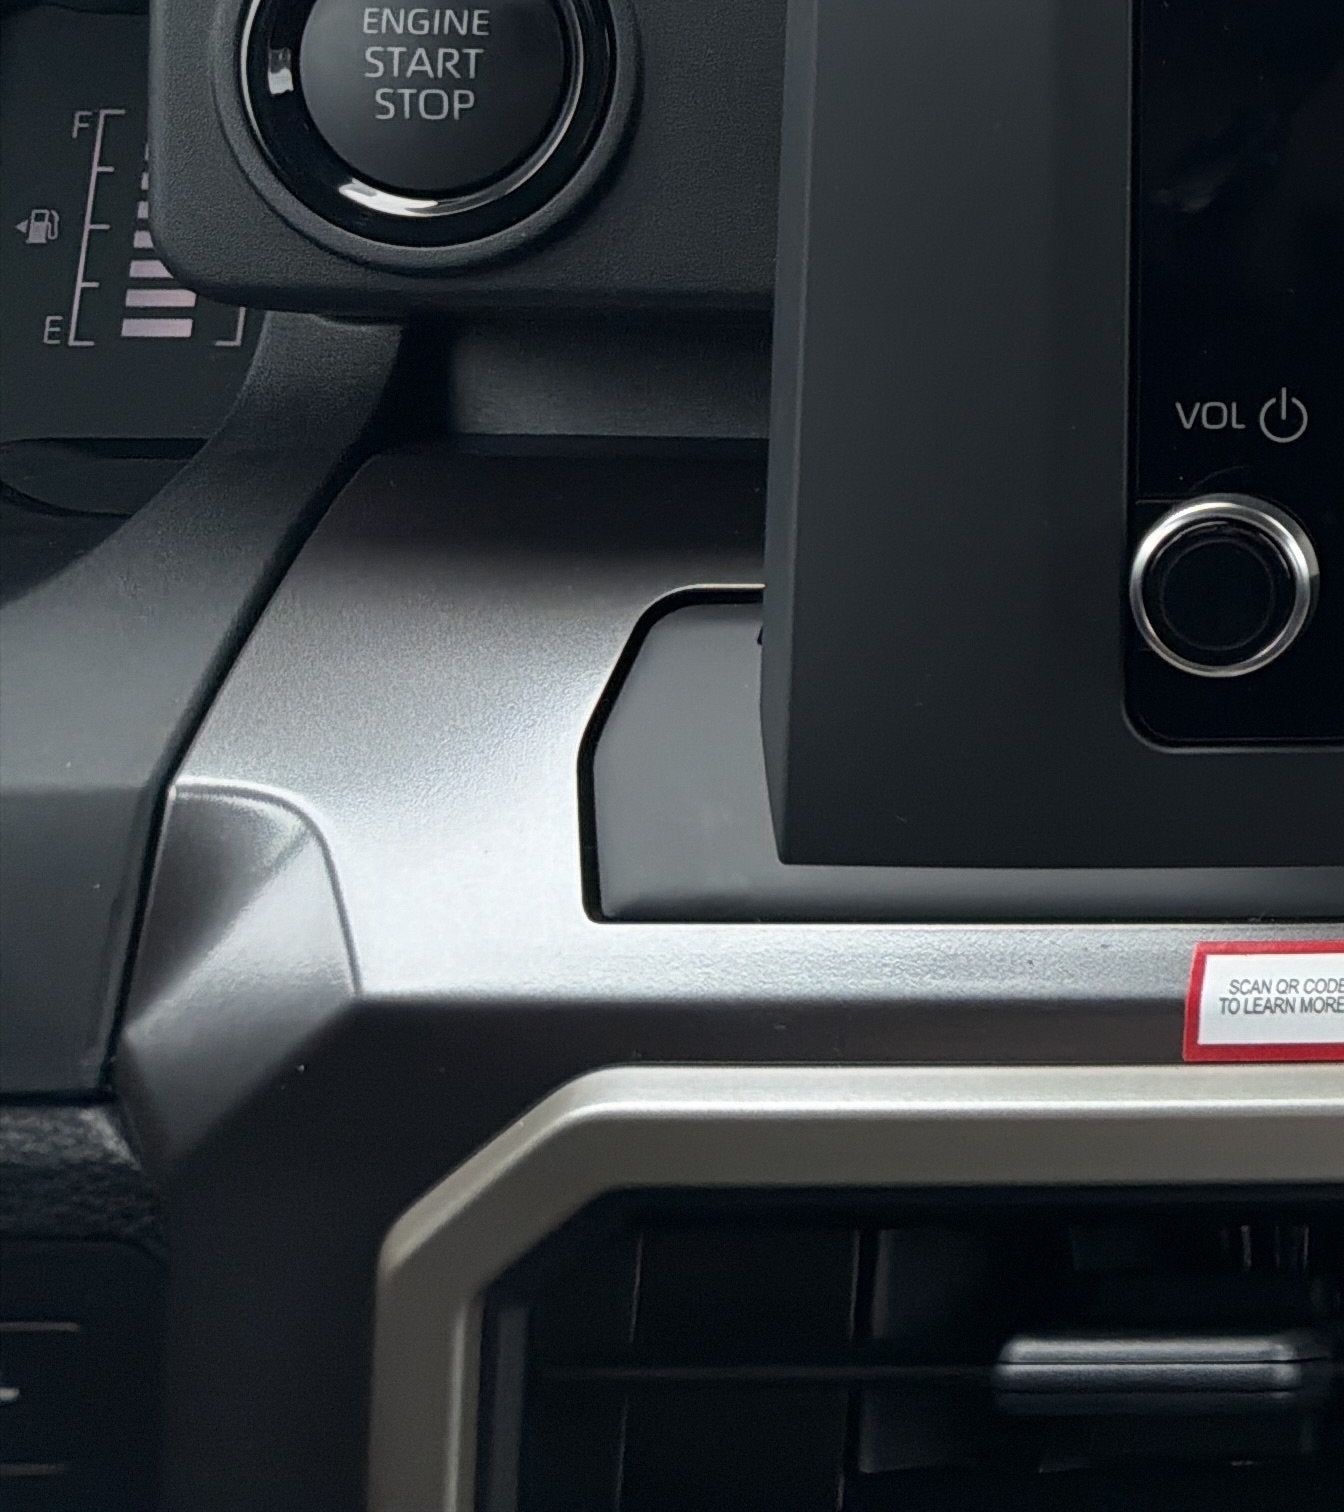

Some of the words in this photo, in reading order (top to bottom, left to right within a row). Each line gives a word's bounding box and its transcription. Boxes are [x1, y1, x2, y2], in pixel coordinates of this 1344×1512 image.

[363, 7, 491, 36] ENGINE
[364, 46, 485, 79] START
[375, 88, 475, 120] STOP
[72, 110, 93, 138] F
[43, 315, 63, 345] E
[1175, 401, 1246, 430] VOL
[1229, 978, 1273, 996] SCAN
[1276, 978, 1300, 994] QR
[1219, 997, 1241, 1015] TO
[1244, 997, 1297, 1014] LEARN
